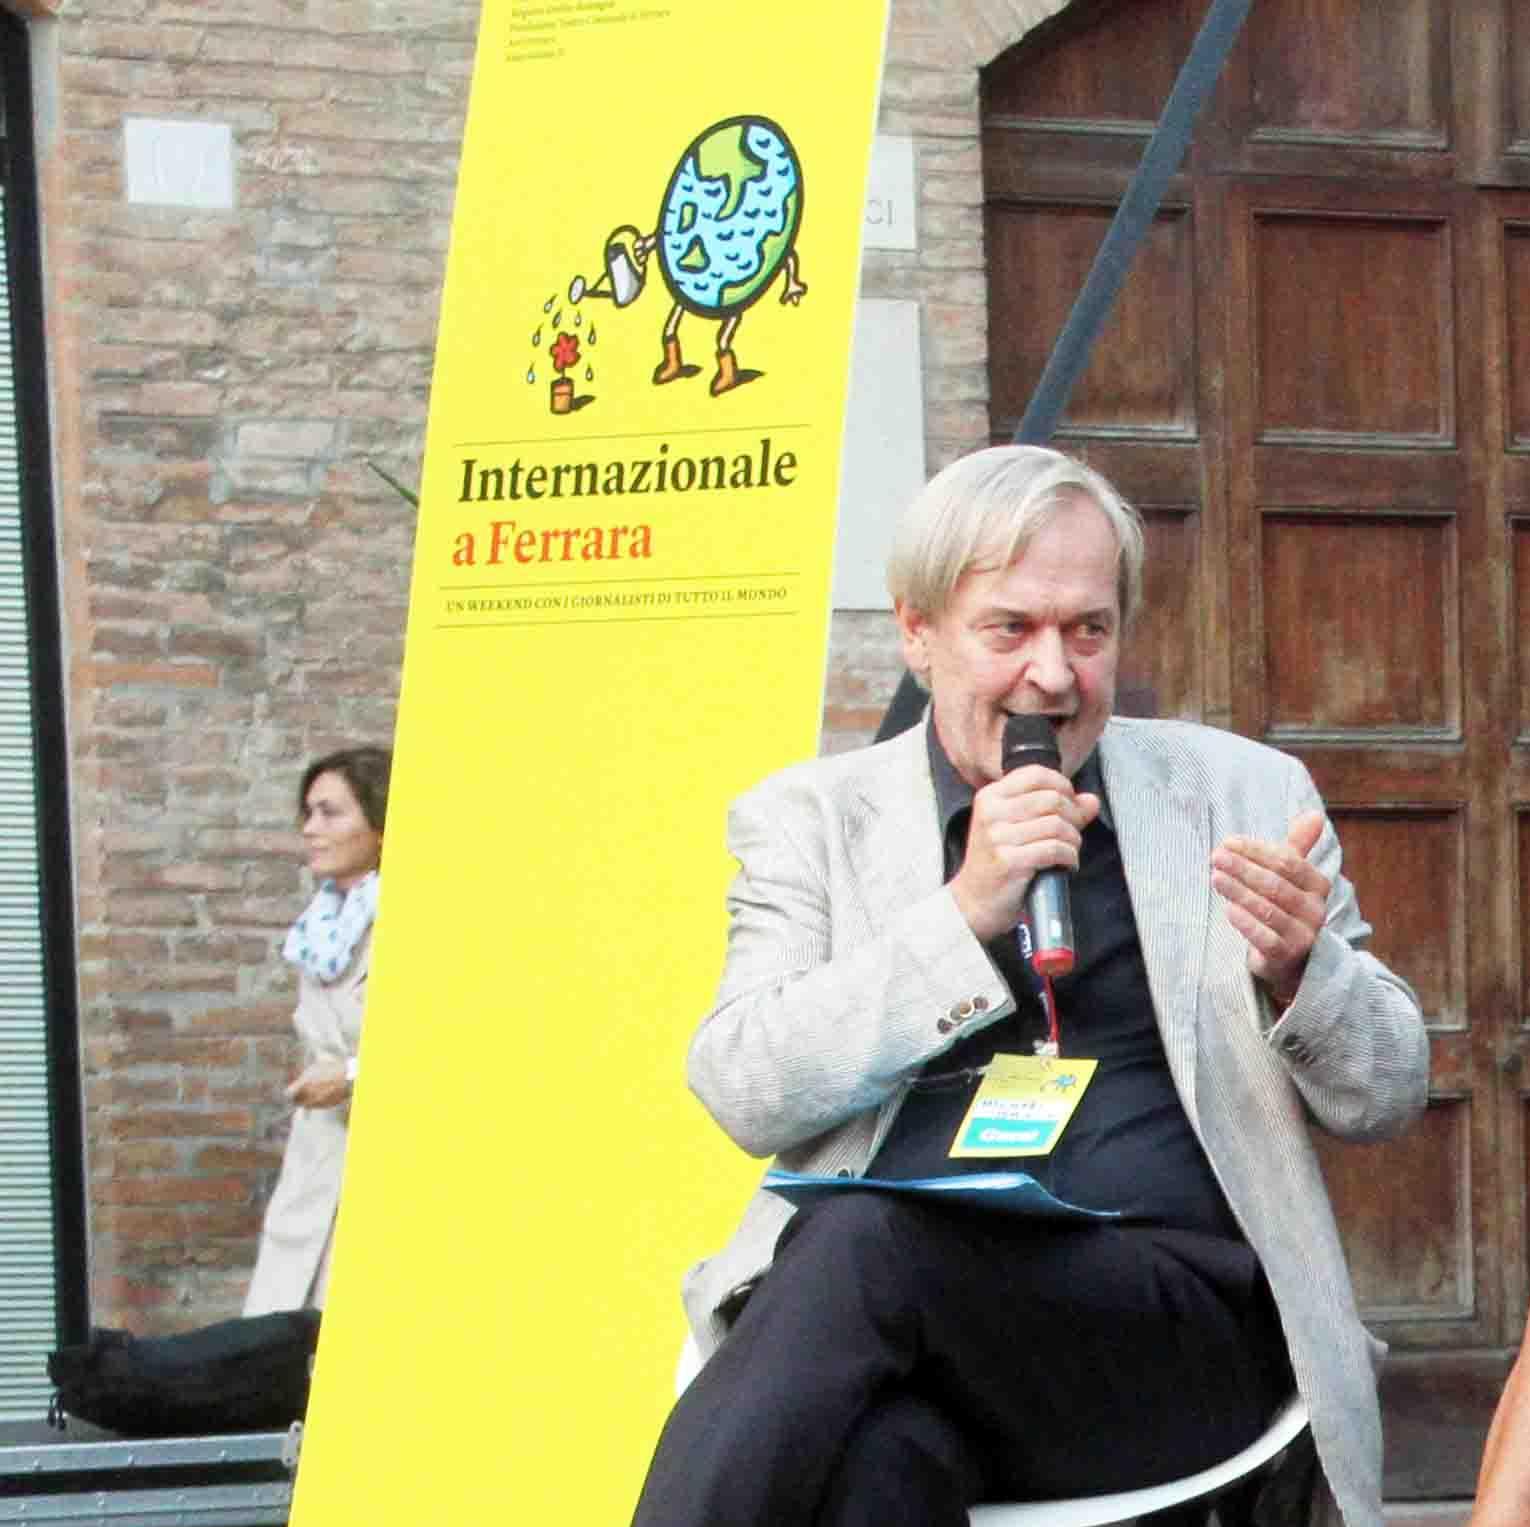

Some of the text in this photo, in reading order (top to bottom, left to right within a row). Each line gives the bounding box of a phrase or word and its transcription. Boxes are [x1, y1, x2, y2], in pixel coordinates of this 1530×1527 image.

[458, 438, 797, 502] Internazionale
[452, 520, 653, 567] a Ferrara
[466, 598, 532, 612] WEEKEND
[534, 597, 561, 609] CON
[571, 592, 654, 608] GIORNALISTI
[656, 592, 671, 605] DI
[675, 591, 719, 605] TUTTO
[737, 586, 788, 601] MONDO
